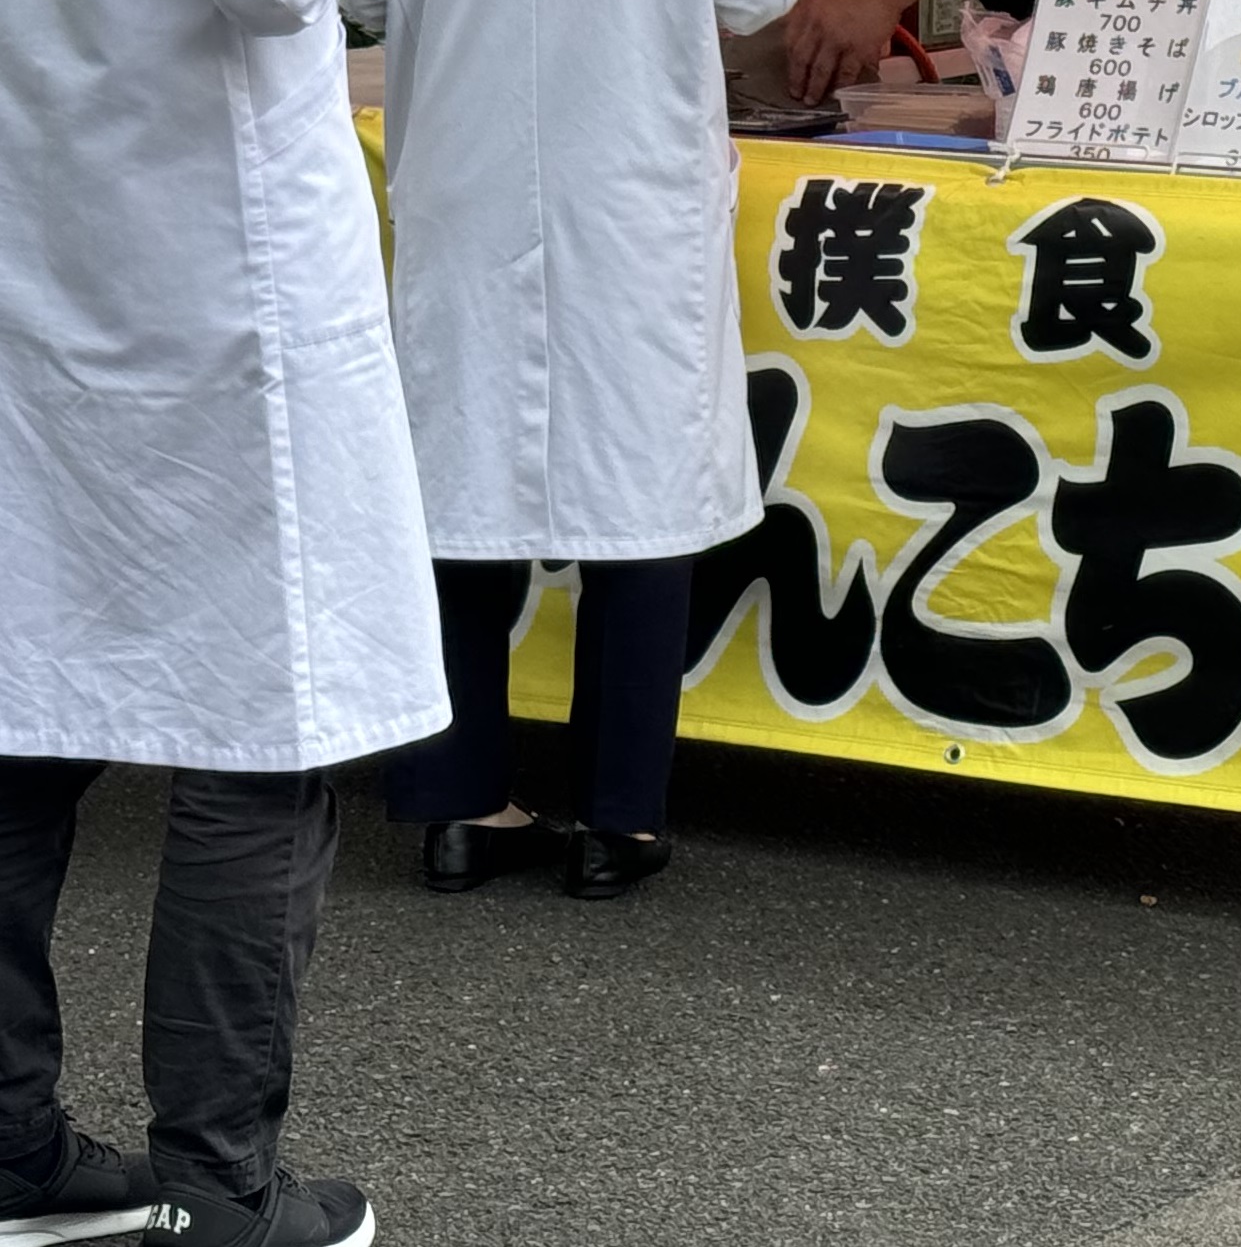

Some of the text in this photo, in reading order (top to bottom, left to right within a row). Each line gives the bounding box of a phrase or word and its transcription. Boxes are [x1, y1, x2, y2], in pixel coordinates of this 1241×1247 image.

[1100, 14, 1142, 33] 700
[1089, 58, 1132, 77] 600
[1078, 102, 1122, 121] 600
[1025, 119, 1168, 146] フライドポテト
[1070, 145, 1111, 160] 350
